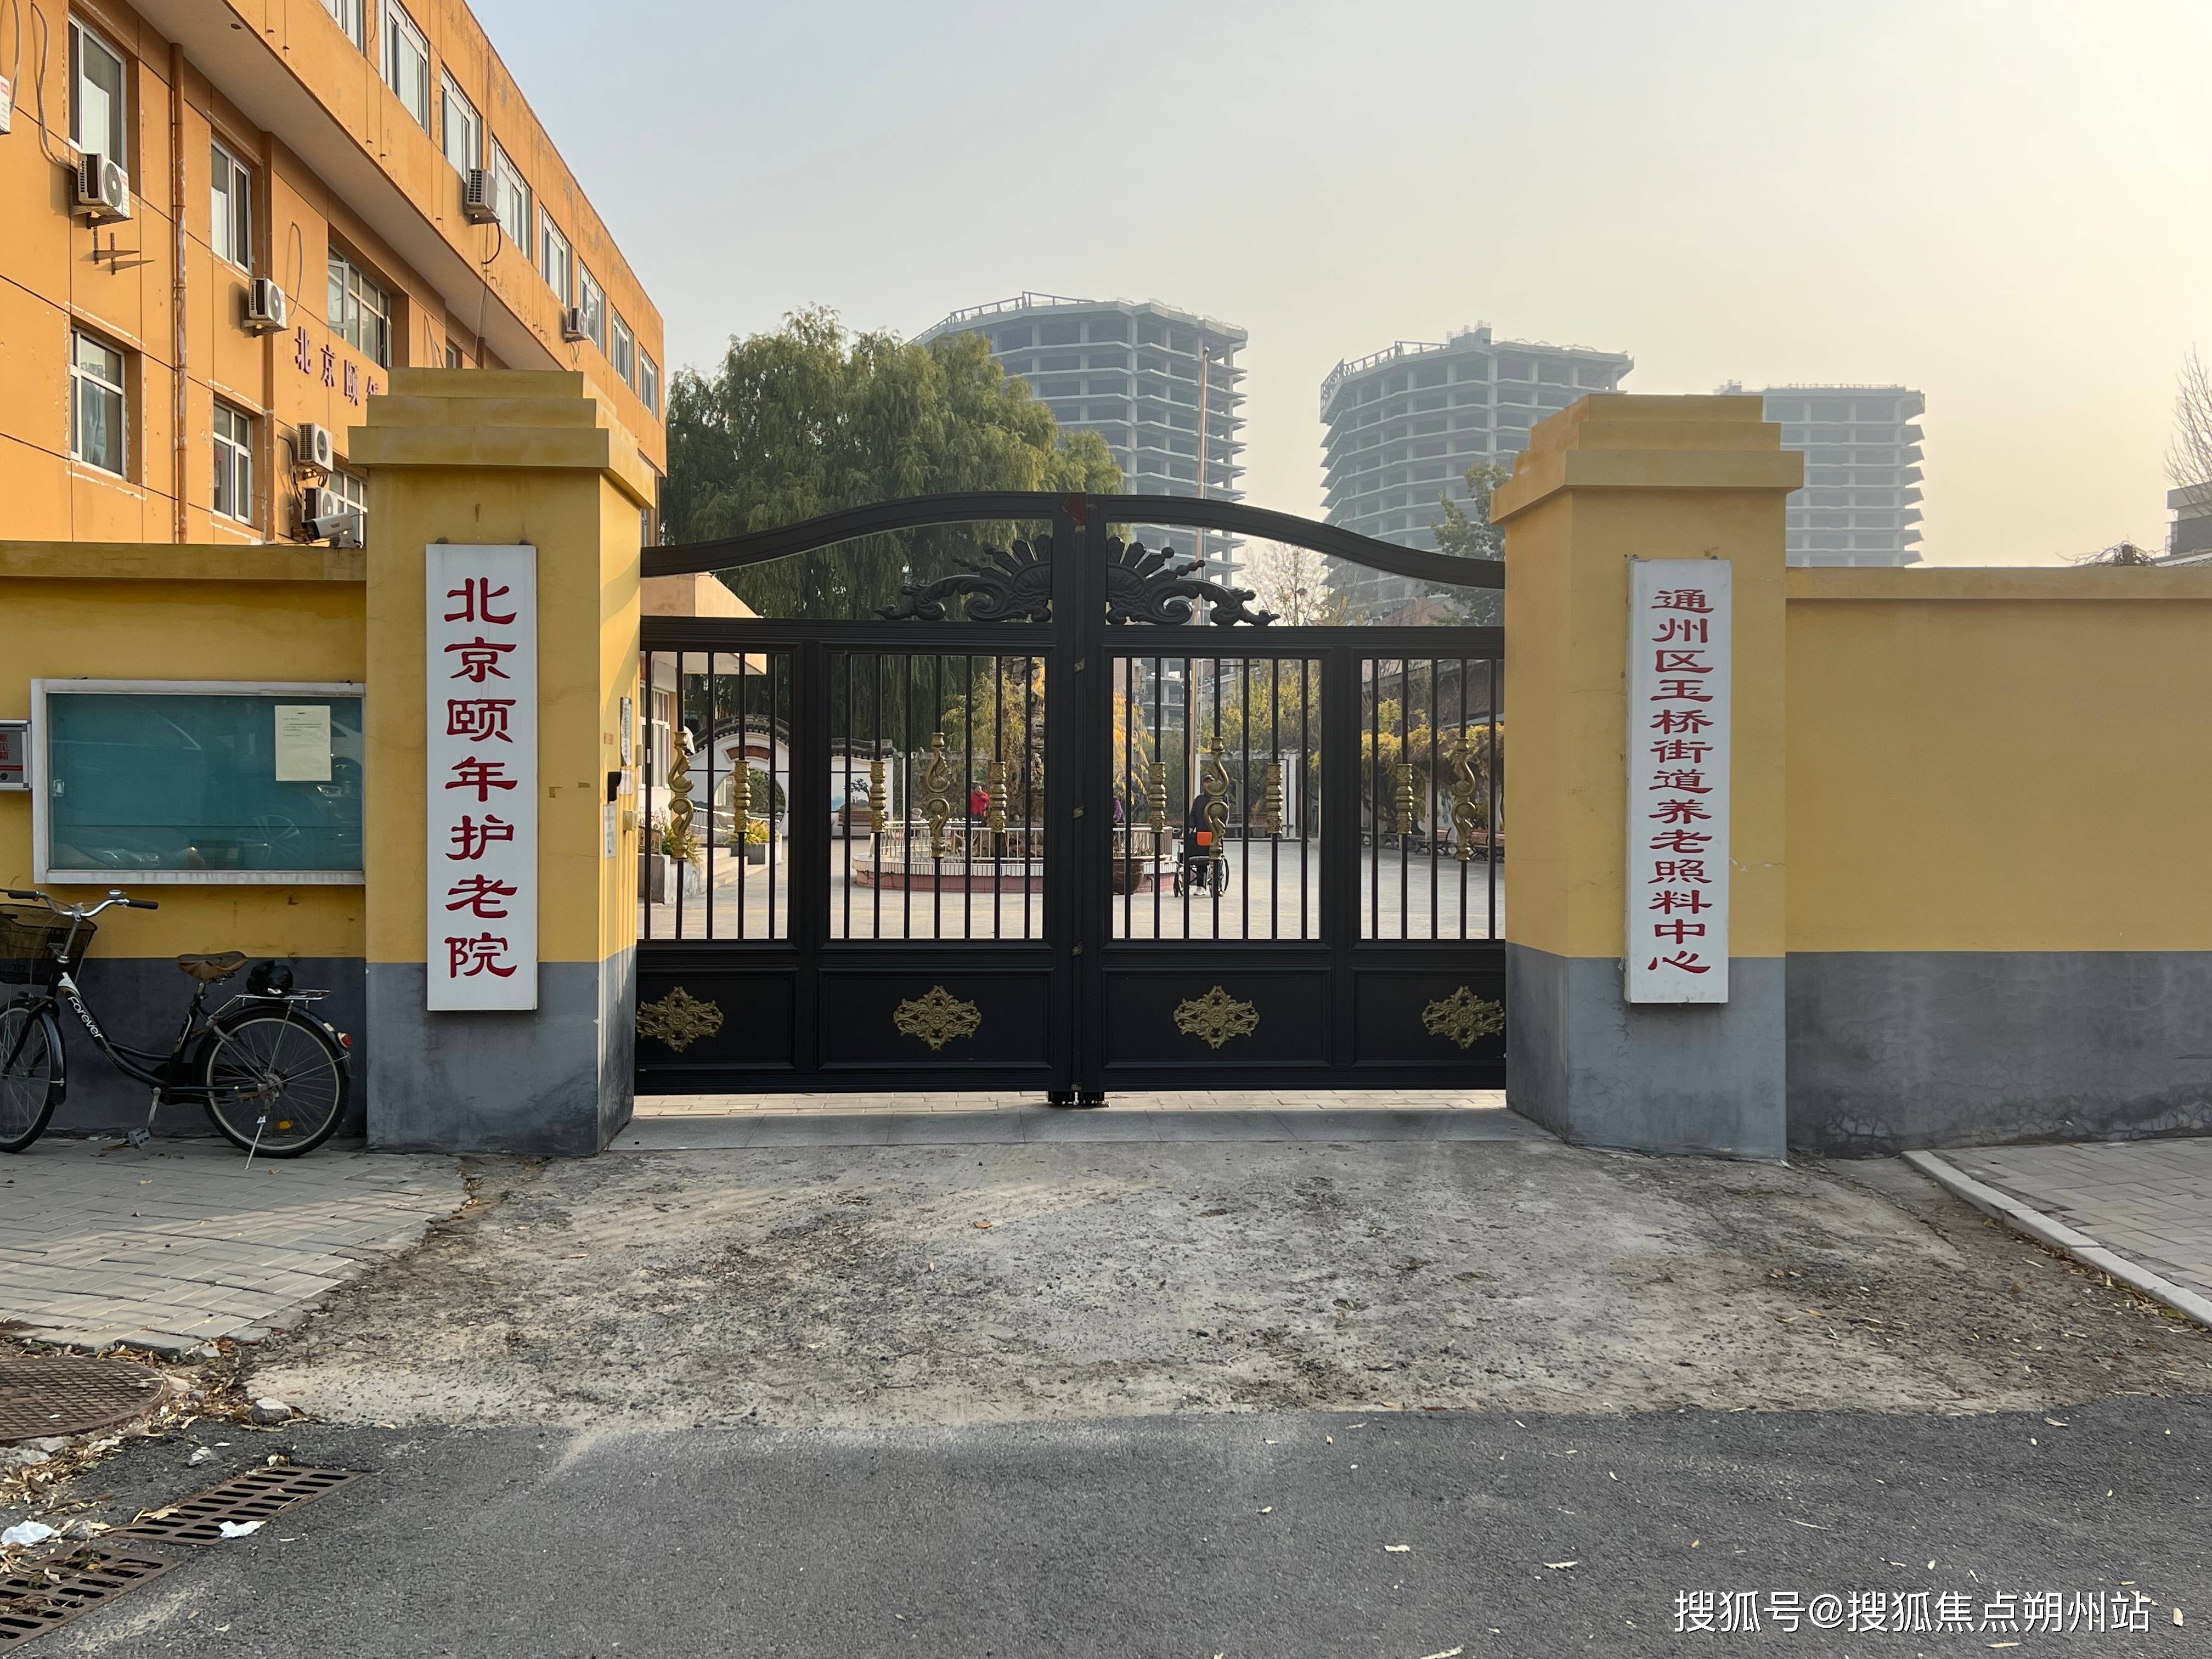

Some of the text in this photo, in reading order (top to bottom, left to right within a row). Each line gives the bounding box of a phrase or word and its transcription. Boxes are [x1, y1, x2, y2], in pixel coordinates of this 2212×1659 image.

[444, 577, 517, 979] 北京颐年护老院
[1648, 589, 1714, 973] 通州区玉桥街道养老照料中心
[67, 996, 103, 1038] Forever
